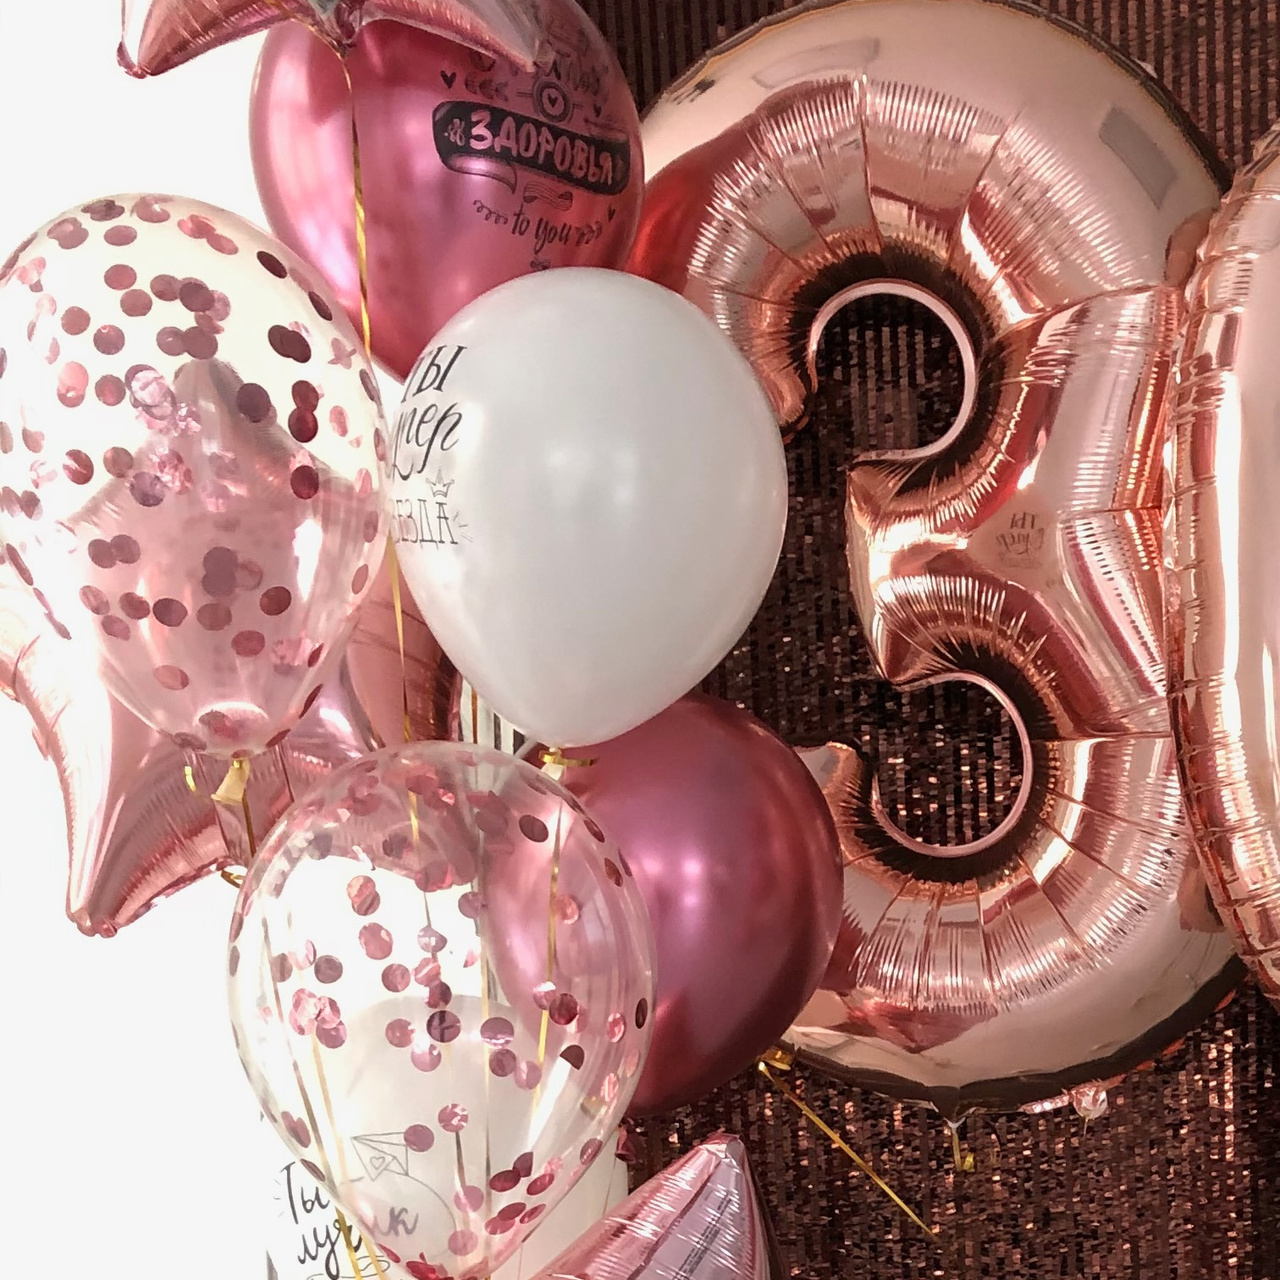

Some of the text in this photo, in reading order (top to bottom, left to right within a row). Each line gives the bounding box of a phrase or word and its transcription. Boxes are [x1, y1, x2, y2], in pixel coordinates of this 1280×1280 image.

[469, 110, 613, 186] ЗДОРОВЬЯ
[512, 204, 571, 255] to you
[280, 1161, 330, 1225] Ты
